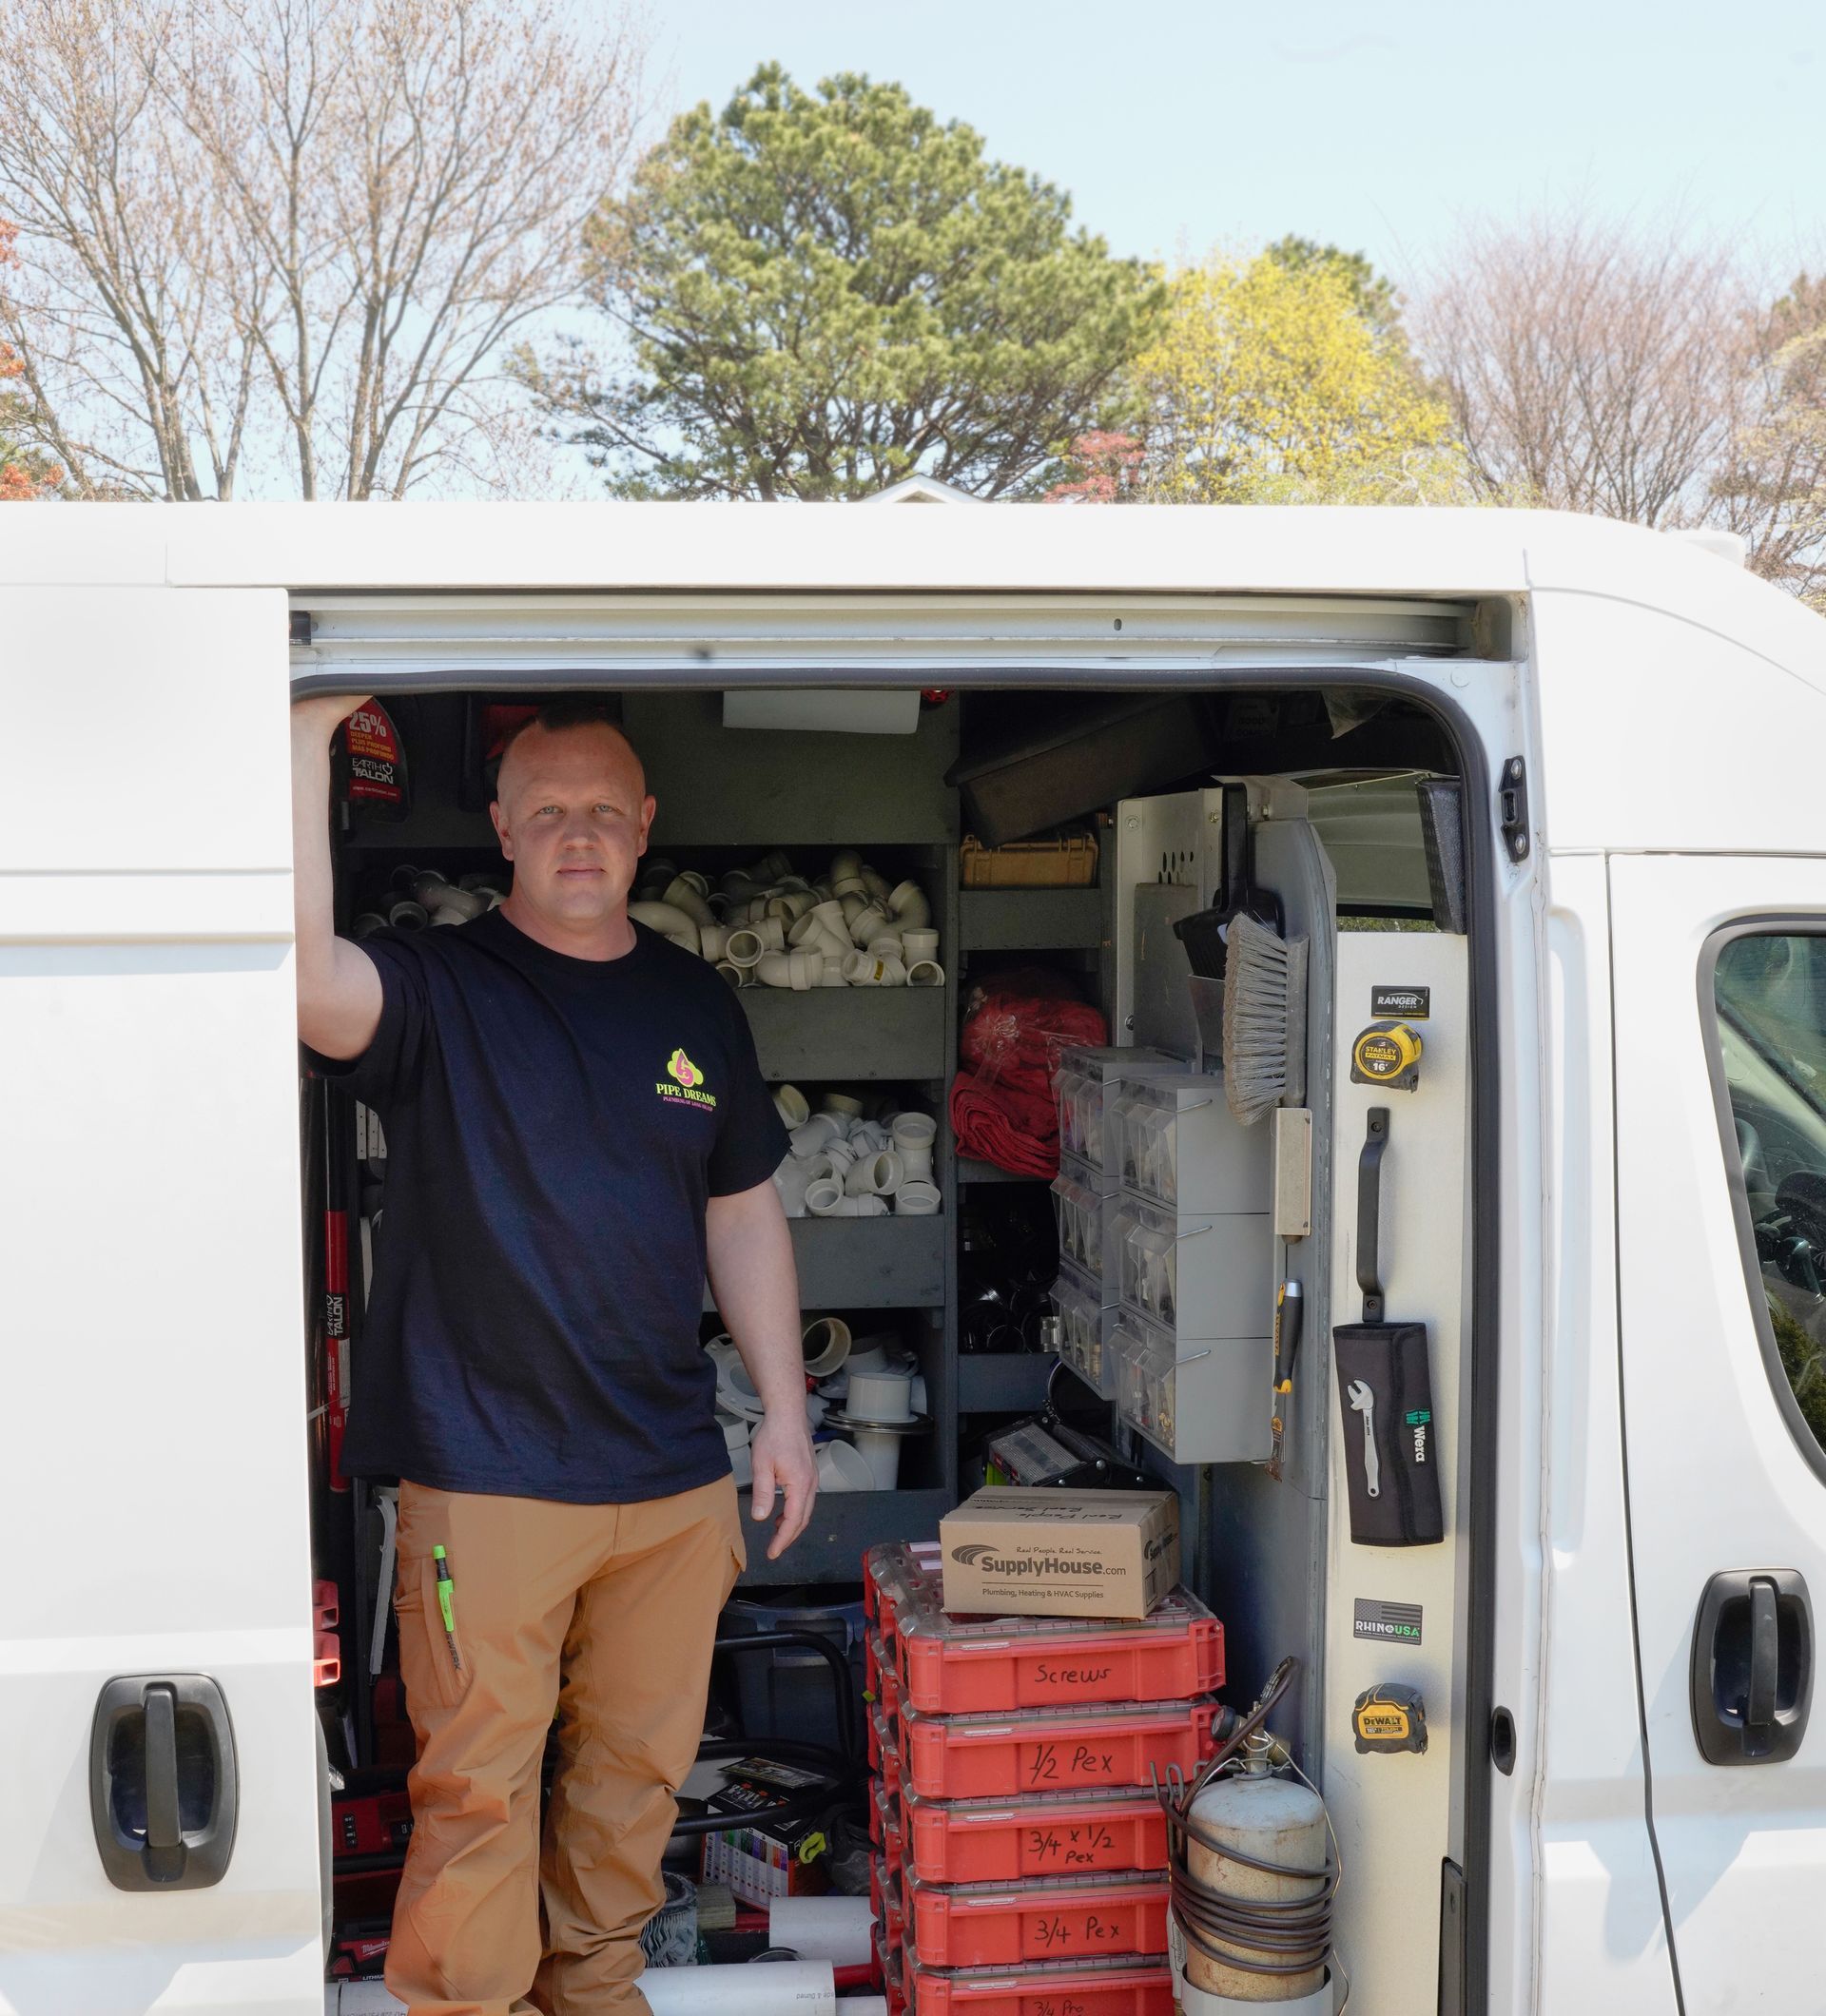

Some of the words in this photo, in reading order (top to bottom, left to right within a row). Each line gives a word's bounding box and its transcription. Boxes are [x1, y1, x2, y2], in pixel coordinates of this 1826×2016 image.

[350, 711, 387, 737] 25%
[352, 767, 393, 784] TALON
[1377, 997, 1417, 1005] RANGER
[1366, 1047, 1396, 1055] STANLEY
[656, 1083, 681, 1096] PIPE
[683, 1088, 716, 1106] DREAMS
[334, 1296, 343, 1336] TALON
[1414, 1425, 1425, 1462] Wera
[981, 1556, 1126, 1577] SupplyHouse.com
[982, 1589, 1017, 1597] Plumbing,
[1019, 1590, 1046, 1598] Heating
[1075, 1590, 1104, 1599] Supplies
[1035, 1664, 1111, 1683] Screws
[1029, 1744, 1059, 1784] 1/2
[1071, 1746, 1113, 1773] Pex
[1028, 1831, 1061, 1861] 3/4
[1088, 1825, 1115, 1848] 1/2
[1065, 1850, 1094, 1864] Pex
[1035, 1917, 1071, 1948] 3/4
[1086, 1916, 1119, 1940] Pex
